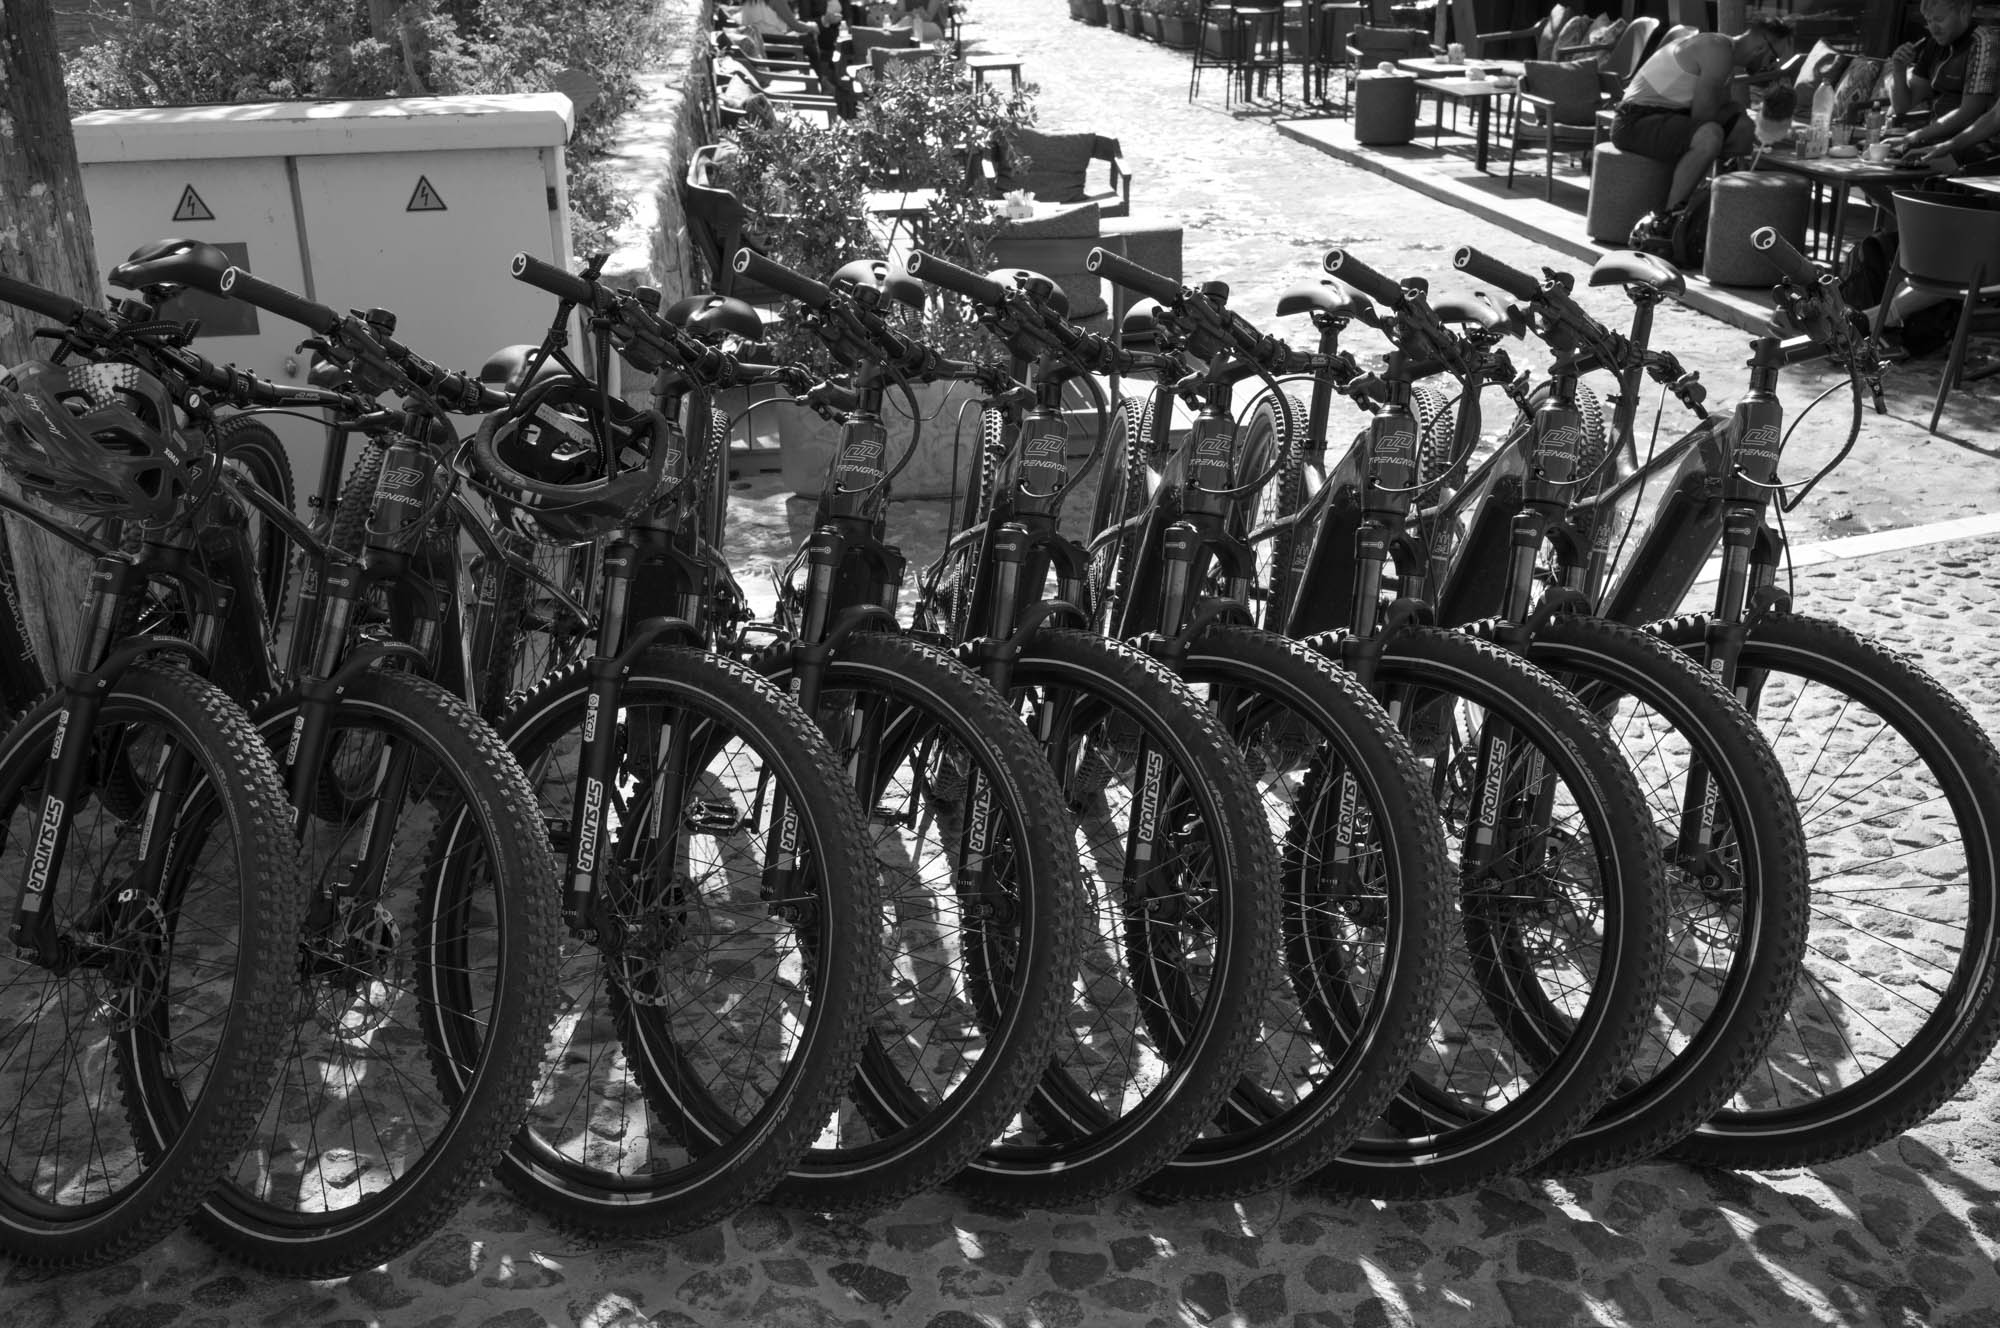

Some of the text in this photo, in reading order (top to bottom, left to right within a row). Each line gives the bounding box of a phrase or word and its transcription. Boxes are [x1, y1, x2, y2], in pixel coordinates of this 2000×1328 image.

[52, 726, 66, 757] XCR
[286, 733, 300, 764] XCR
[584, 711, 597, 740] XCR
[1138, 751, 1163, 841] SR SUNTOUR
[1336, 780, 1358, 844] SUNTOUR
[1480, 738, 1507, 826] SR SUNTOUR
[27, 797, 65, 892] SR SUNTOUR
[577, 779, 603, 872] SR SUNTOUR
[969, 788, 991, 852] SUNTOUR
